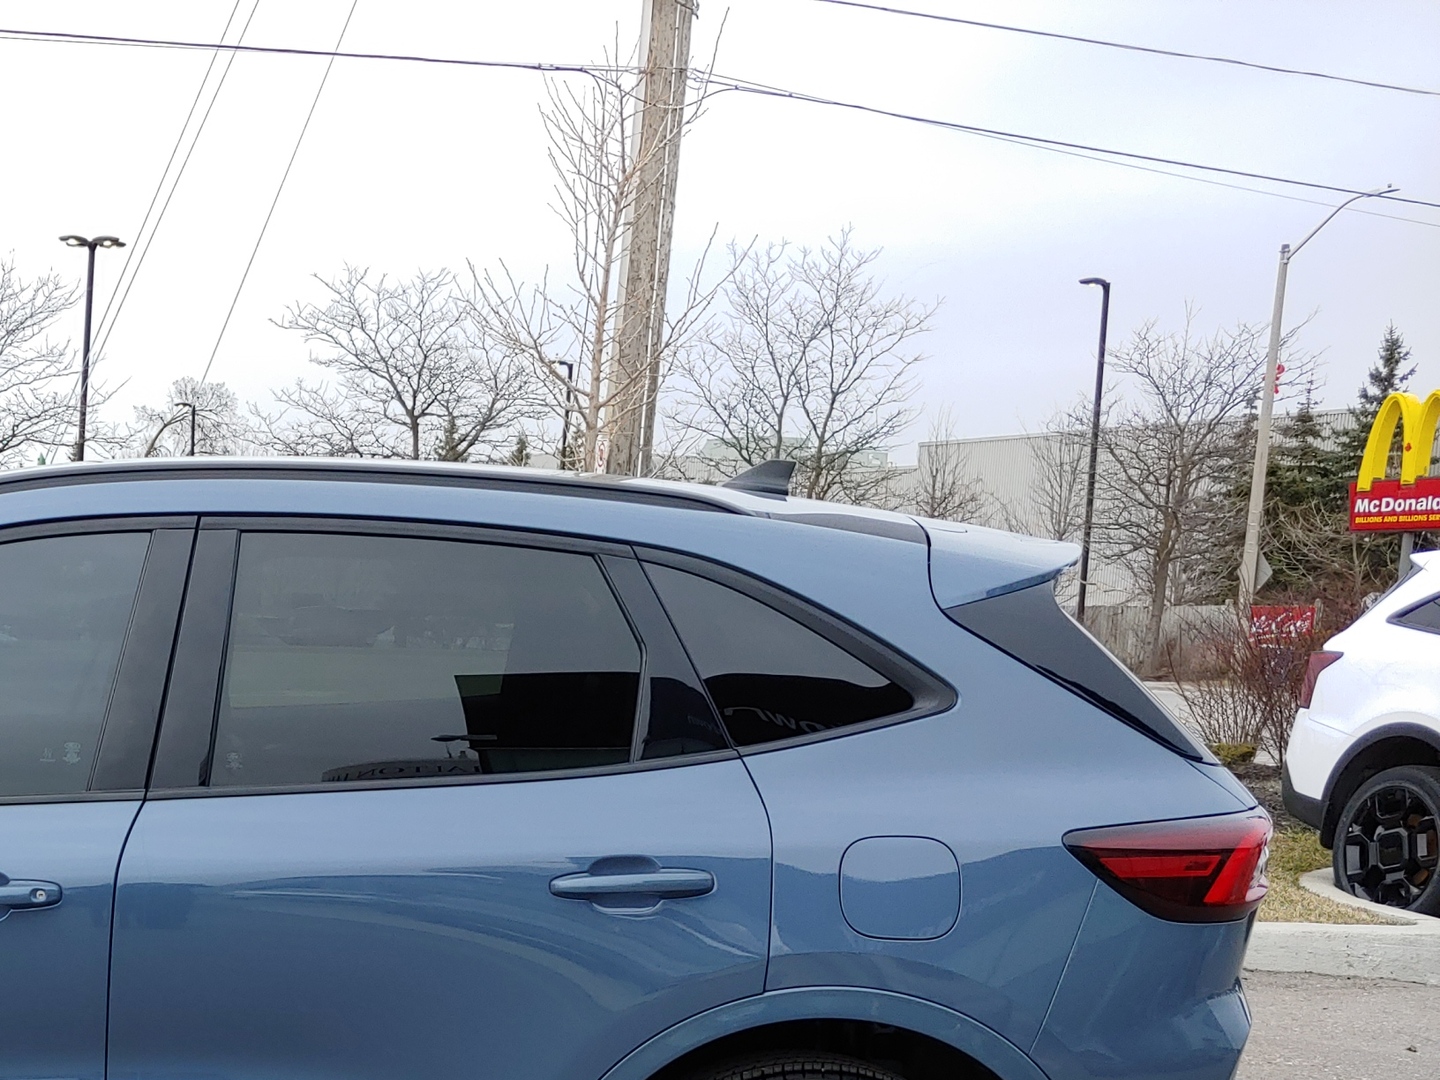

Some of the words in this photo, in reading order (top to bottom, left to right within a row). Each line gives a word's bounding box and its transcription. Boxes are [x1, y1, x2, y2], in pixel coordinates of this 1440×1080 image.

[1355, 516, 1383, 524] BILLIONS
[1383, 515, 1398, 523] AND
[1398, 514, 1428, 522] BILLIONS
